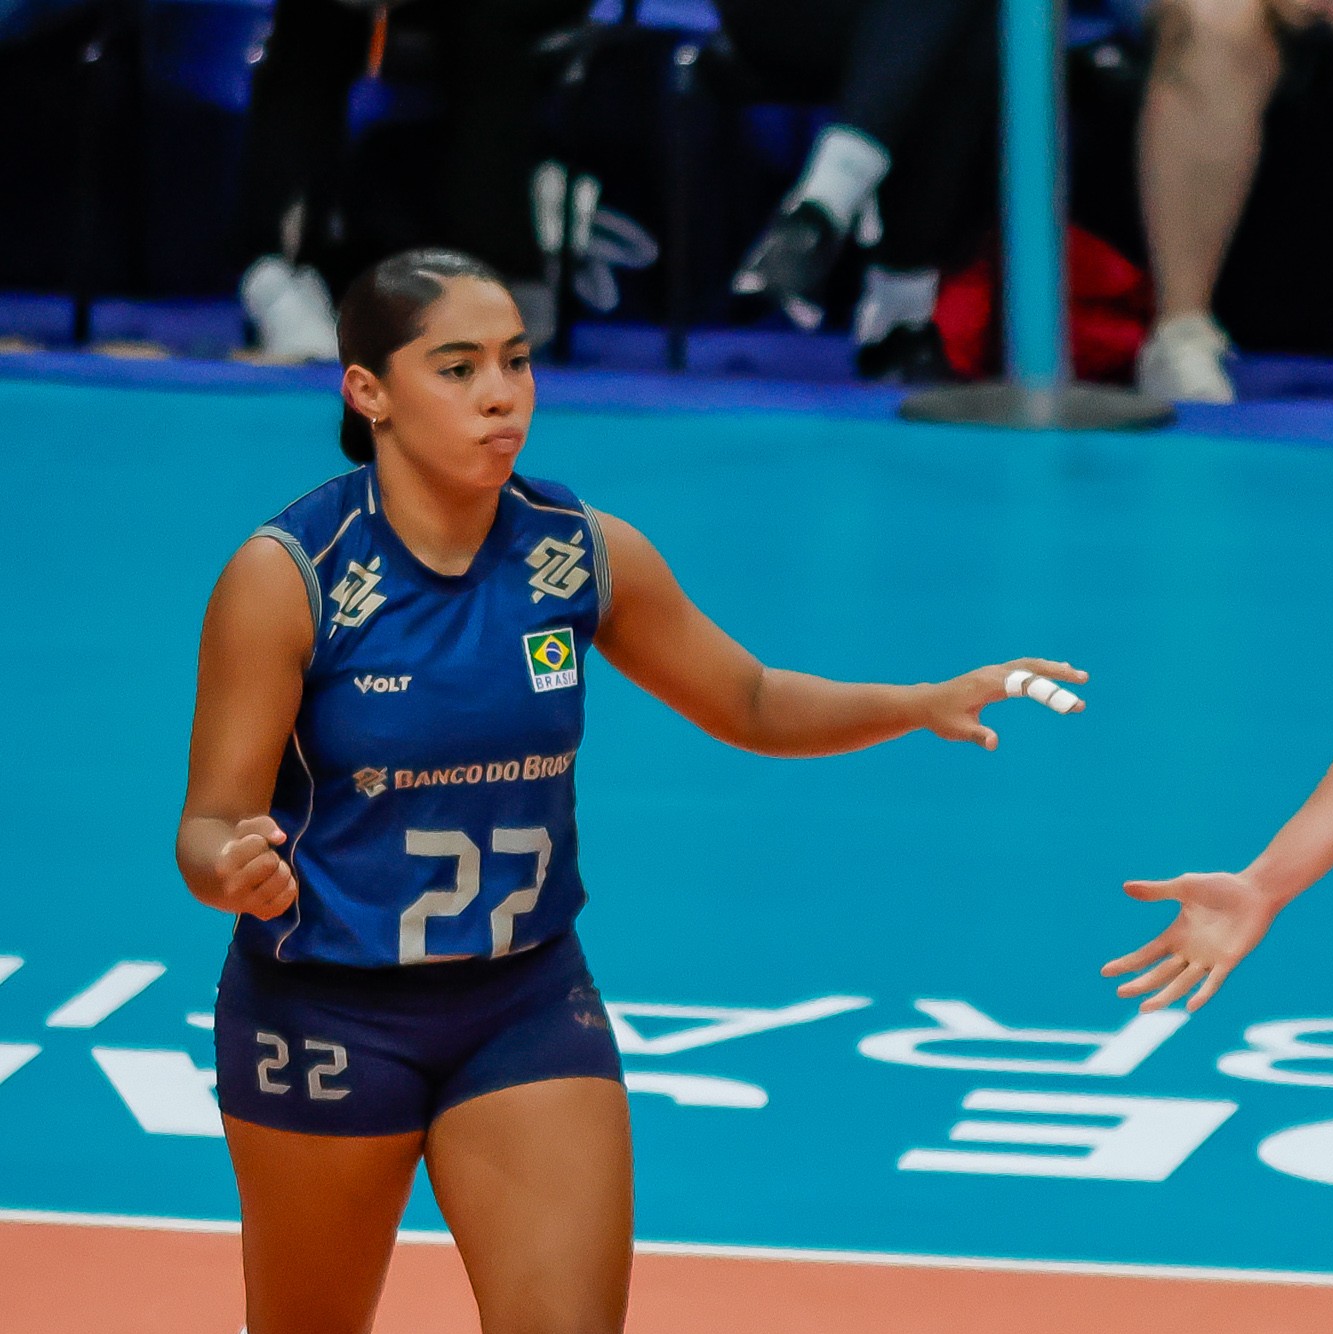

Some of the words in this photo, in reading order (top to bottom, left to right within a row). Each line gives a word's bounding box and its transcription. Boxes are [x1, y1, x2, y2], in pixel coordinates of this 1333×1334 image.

[354, 674, 413, 694] VOLT
[535, 672, 578, 690] BRASIL
[394, 764, 482, 790] BANCO
[486, 760, 520, 783] DO
[399, 827, 553, 965] 22
[255, 1031, 352, 1100] 22
